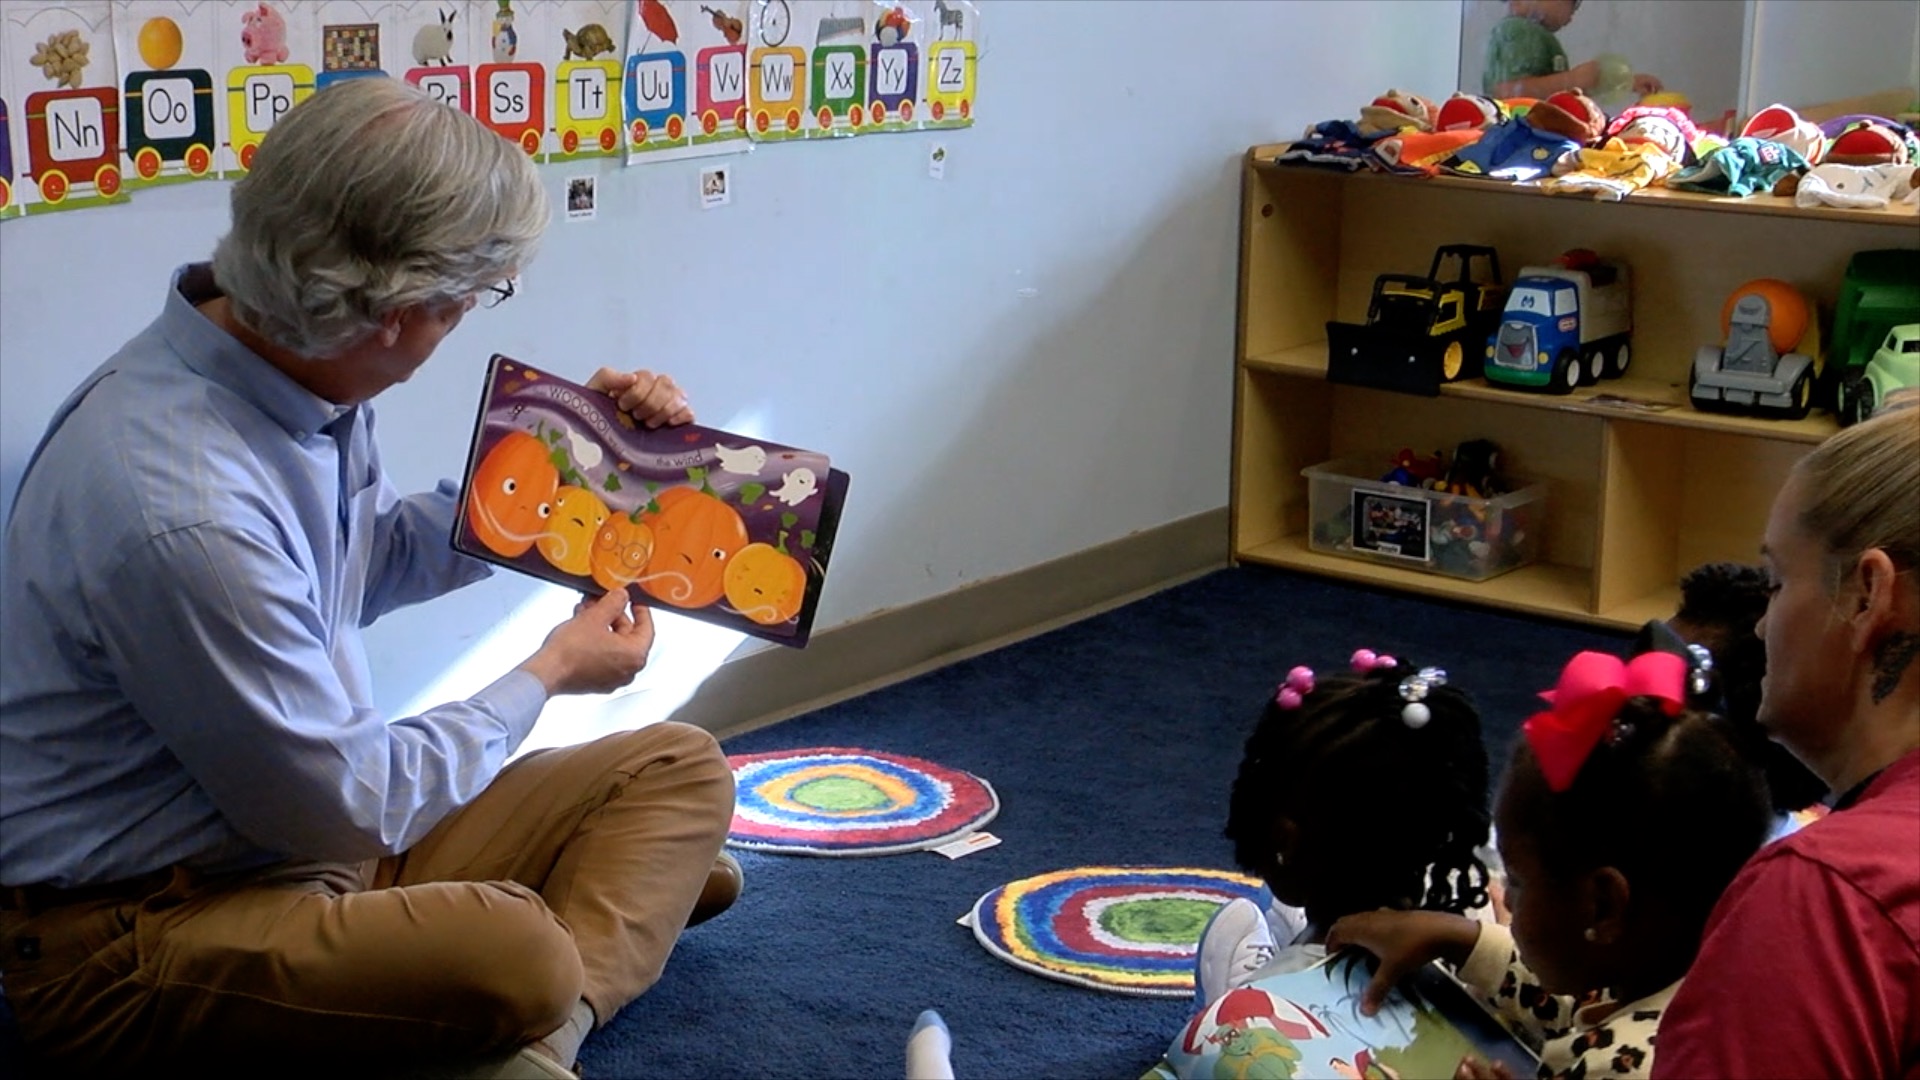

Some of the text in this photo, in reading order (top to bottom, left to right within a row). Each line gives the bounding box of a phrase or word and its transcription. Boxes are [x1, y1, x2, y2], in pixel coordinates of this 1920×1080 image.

[641, 70, 670, 102] Uu
[714, 62, 740, 93] Vv
[763, 63, 793, 93] Ww
[830, 61, 853, 91] Xx
[881, 57, 904, 92] Yy
[940, 56, 963, 85] Zz
[148, 87, 187, 125] Oo
[252, 83, 290, 122] Pp
[493, 81, 524, 114] Ss
[575, 78, 603, 110] Tt
[54, 110, 99, 150] Nn
[674, 449, 703, 467] wind
